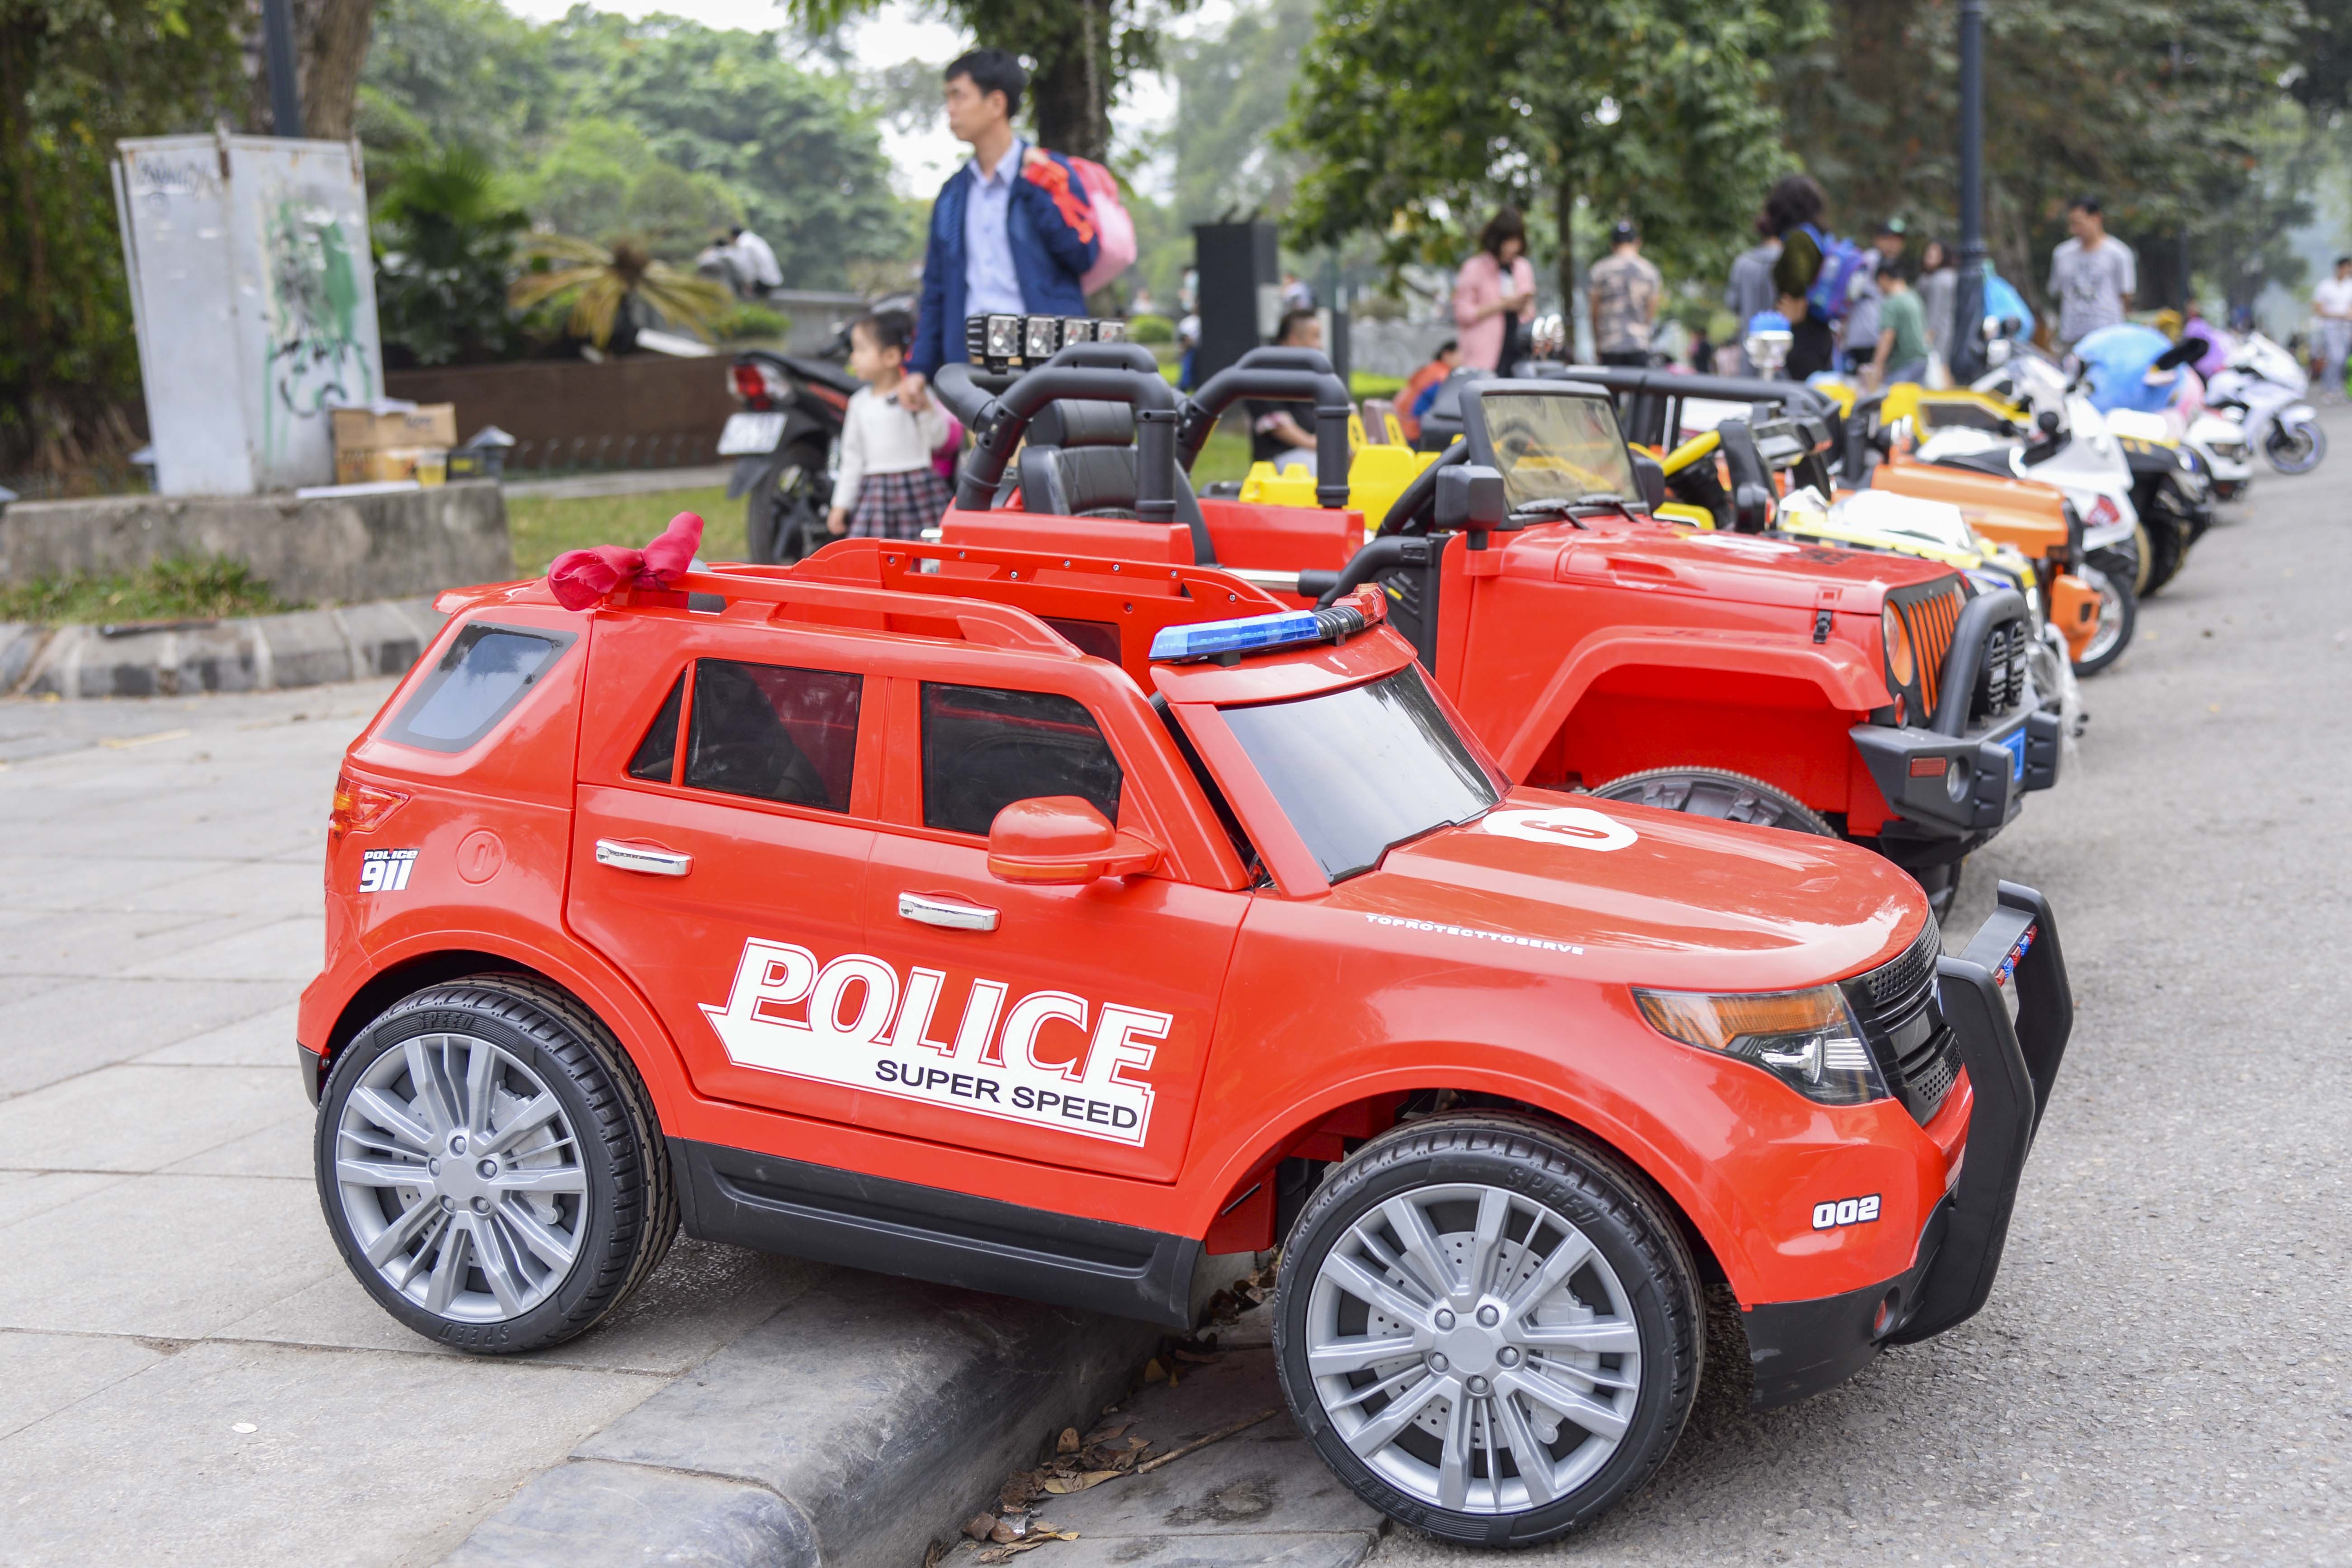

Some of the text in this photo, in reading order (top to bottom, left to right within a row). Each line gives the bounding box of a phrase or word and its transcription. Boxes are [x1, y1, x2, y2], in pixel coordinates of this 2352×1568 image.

[359, 859, 414, 893] 911
[416, 1011, 474, 1030] SPEED
[725, 936, 1174, 1096] POLICE
[875, 1059, 1138, 1129] SUPER SPEED
[1505, 1166, 1601, 1225] SPEED
[1812, 1194, 1881, 1230] 002
[438, 1322, 510, 1346] SPEED
